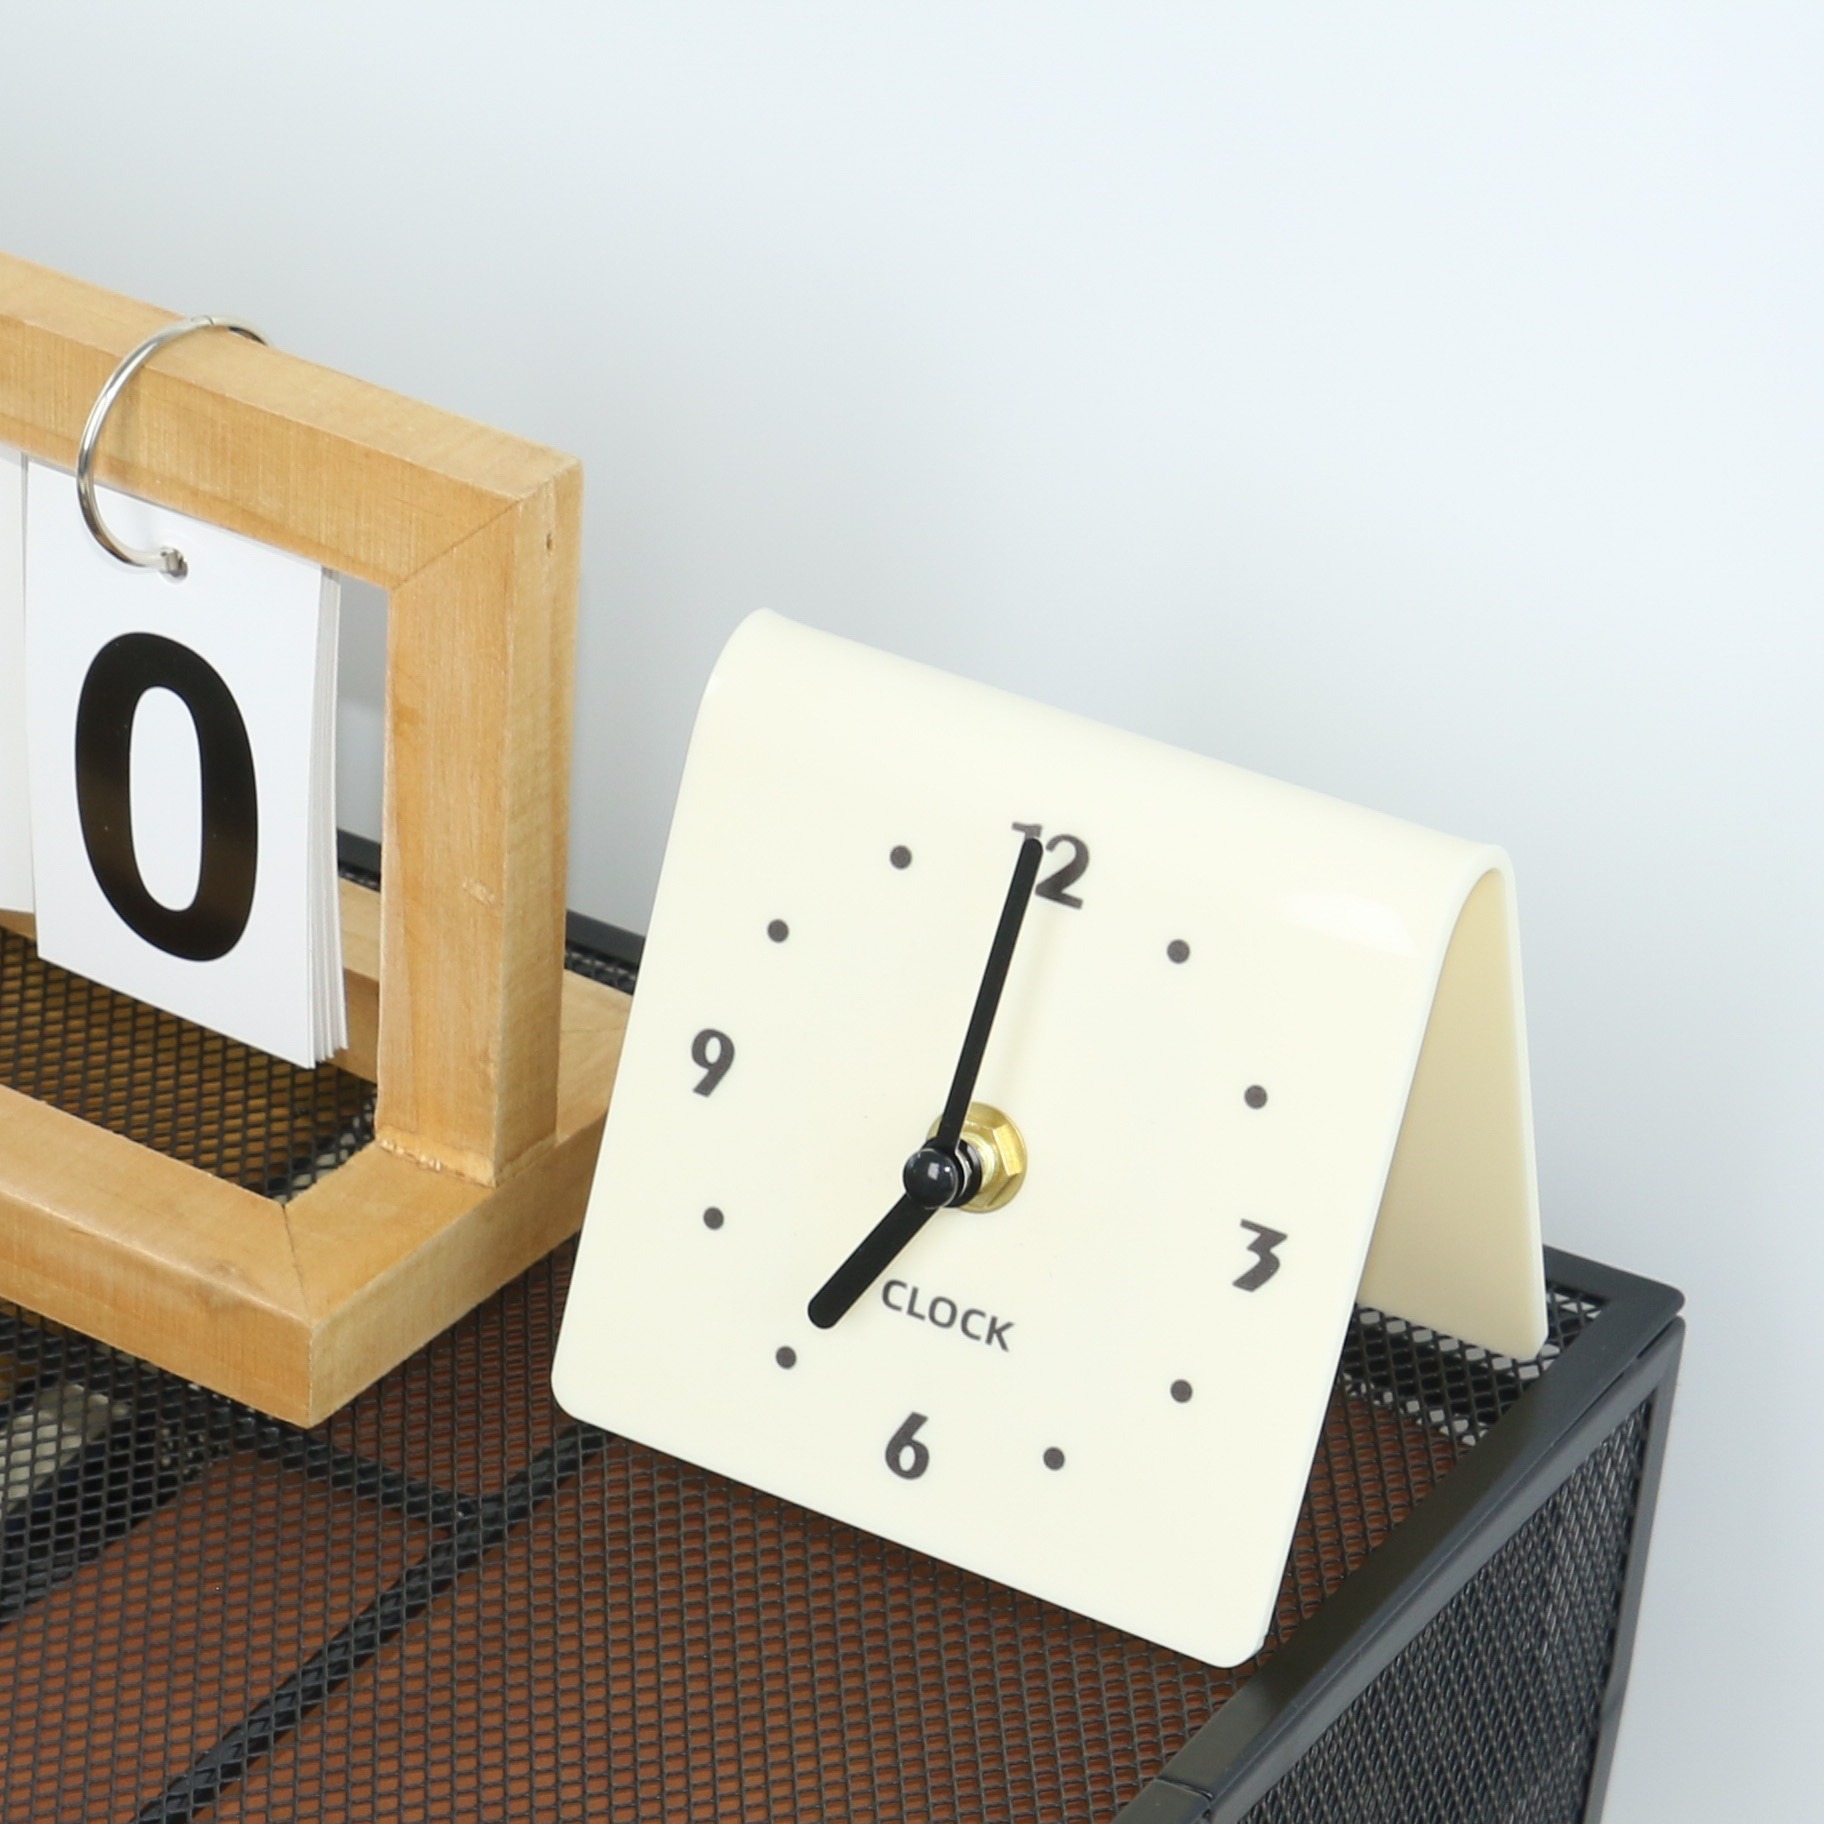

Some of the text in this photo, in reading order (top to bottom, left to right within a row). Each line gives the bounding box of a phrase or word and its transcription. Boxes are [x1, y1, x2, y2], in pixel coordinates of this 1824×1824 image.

[690, 1028, 736, 1098] 9
[1231, 1219, 1288, 1293] 3
[881, 1278, 1015, 1352] CLOCK
[884, 1411, 931, 1481] 6
